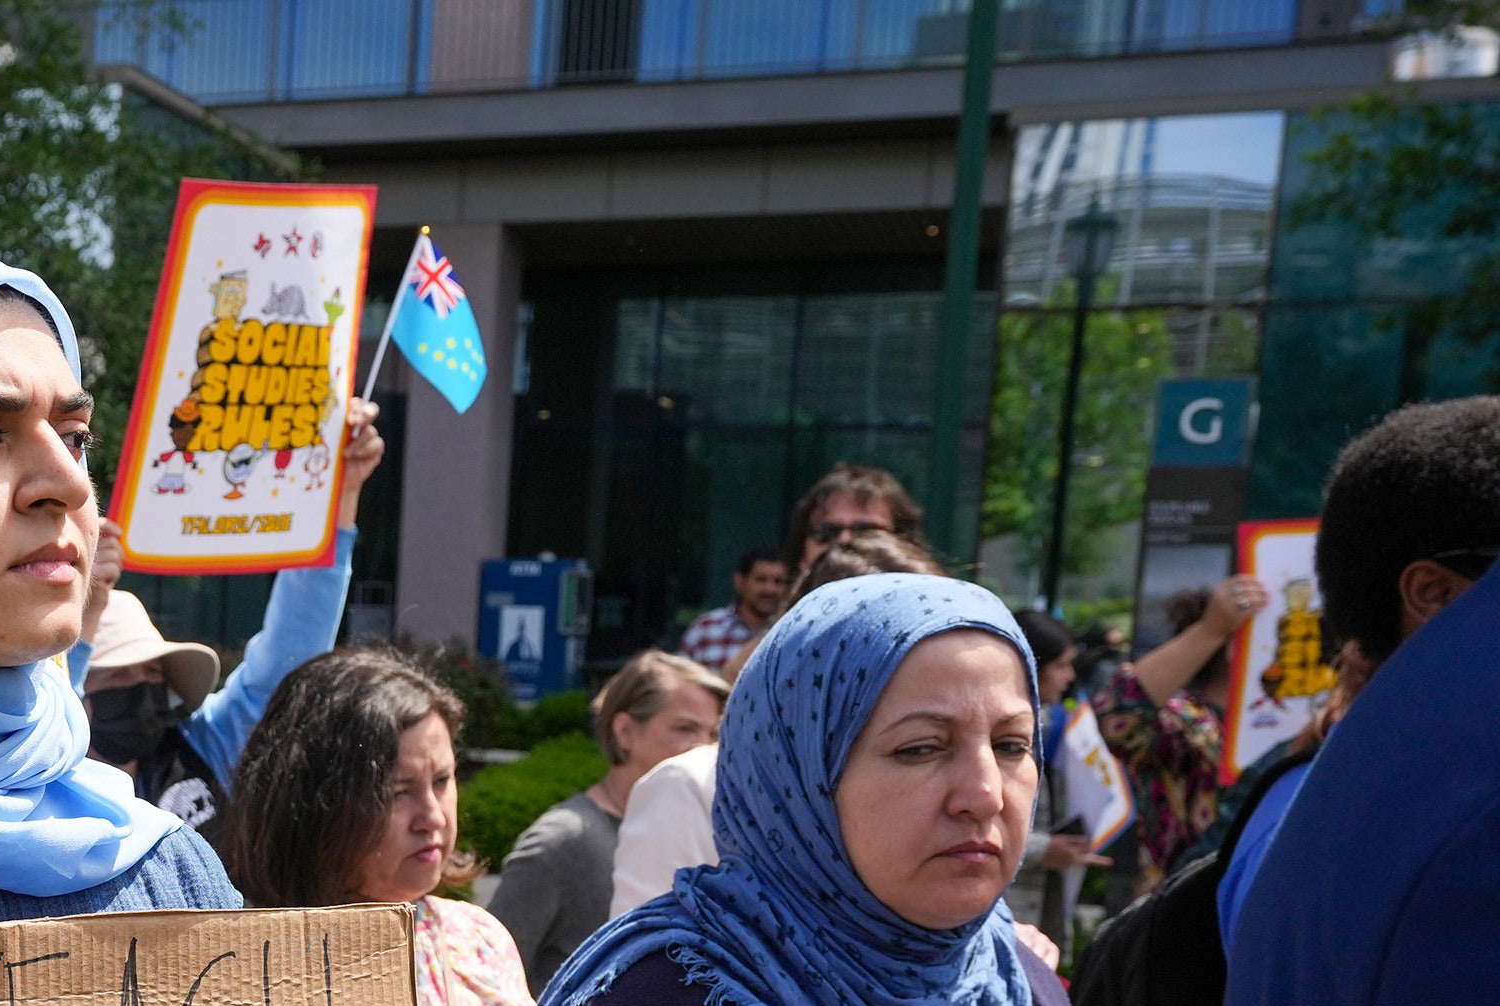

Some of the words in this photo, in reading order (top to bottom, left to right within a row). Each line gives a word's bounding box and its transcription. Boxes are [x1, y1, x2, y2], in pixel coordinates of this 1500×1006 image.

[209, 317, 331, 367] SOCIAL
[201, 362, 330, 404] STUDIES
[1178, 397, 1224, 445] G
